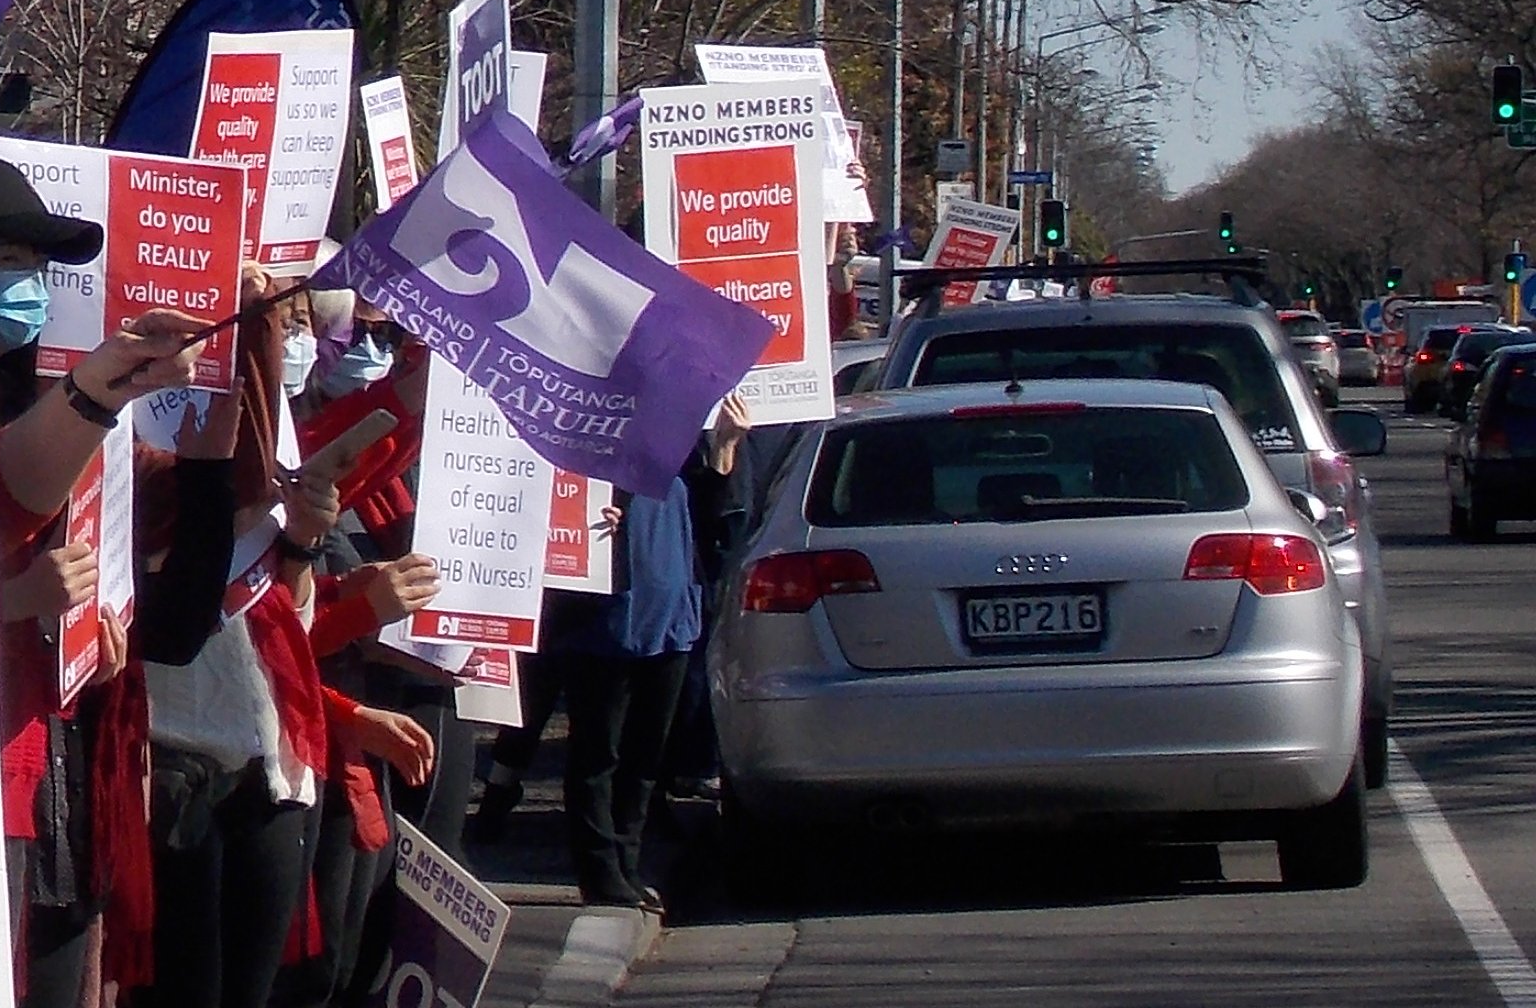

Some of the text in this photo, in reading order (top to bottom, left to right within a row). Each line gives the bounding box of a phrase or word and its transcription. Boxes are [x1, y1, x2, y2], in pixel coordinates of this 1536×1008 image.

[291, 66, 338, 92] Support
[462, 41, 503, 123] TOOT
[210, 82, 275, 108] We provide
[287, 103, 337, 120] us so we
[649, 96, 814, 123] NZNO MEMBERS
[217, 116, 259, 141] quality
[649, 122, 814, 149] STANDING STRONG
[281, 131, 334, 156] can keep
[240, 153, 266, 169] care
[130, 168, 222, 203] Minister,
[271, 166, 334, 191] supporting
[286, 202, 308, 223] you.
[681, 184, 793, 215] We provide
[139, 204, 211, 235] do you
[706, 218, 770, 247] quality
[137, 242, 211, 271] REALLY
[124, 281, 220, 310] value us?
[335, 250, 464, 364] NURSES
[387, 272, 475, 342] ZEALAND
[478, 366, 632, 439] TAPUHI
[768, 381, 819, 397] TAPUHI
[441, 408, 500, 437] Health
[444, 452, 535, 478] nurses are
[451, 485, 522, 516] of equal
[556, 483, 579, 498] UP
[449, 523, 517, 550] value to
[468, 561, 532, 589] Nurses!
[972, 598, 1098, 633] KBP216
[416, 850, 497, 928] MEMBERS
[433, 887, 490, 943] STRONG
